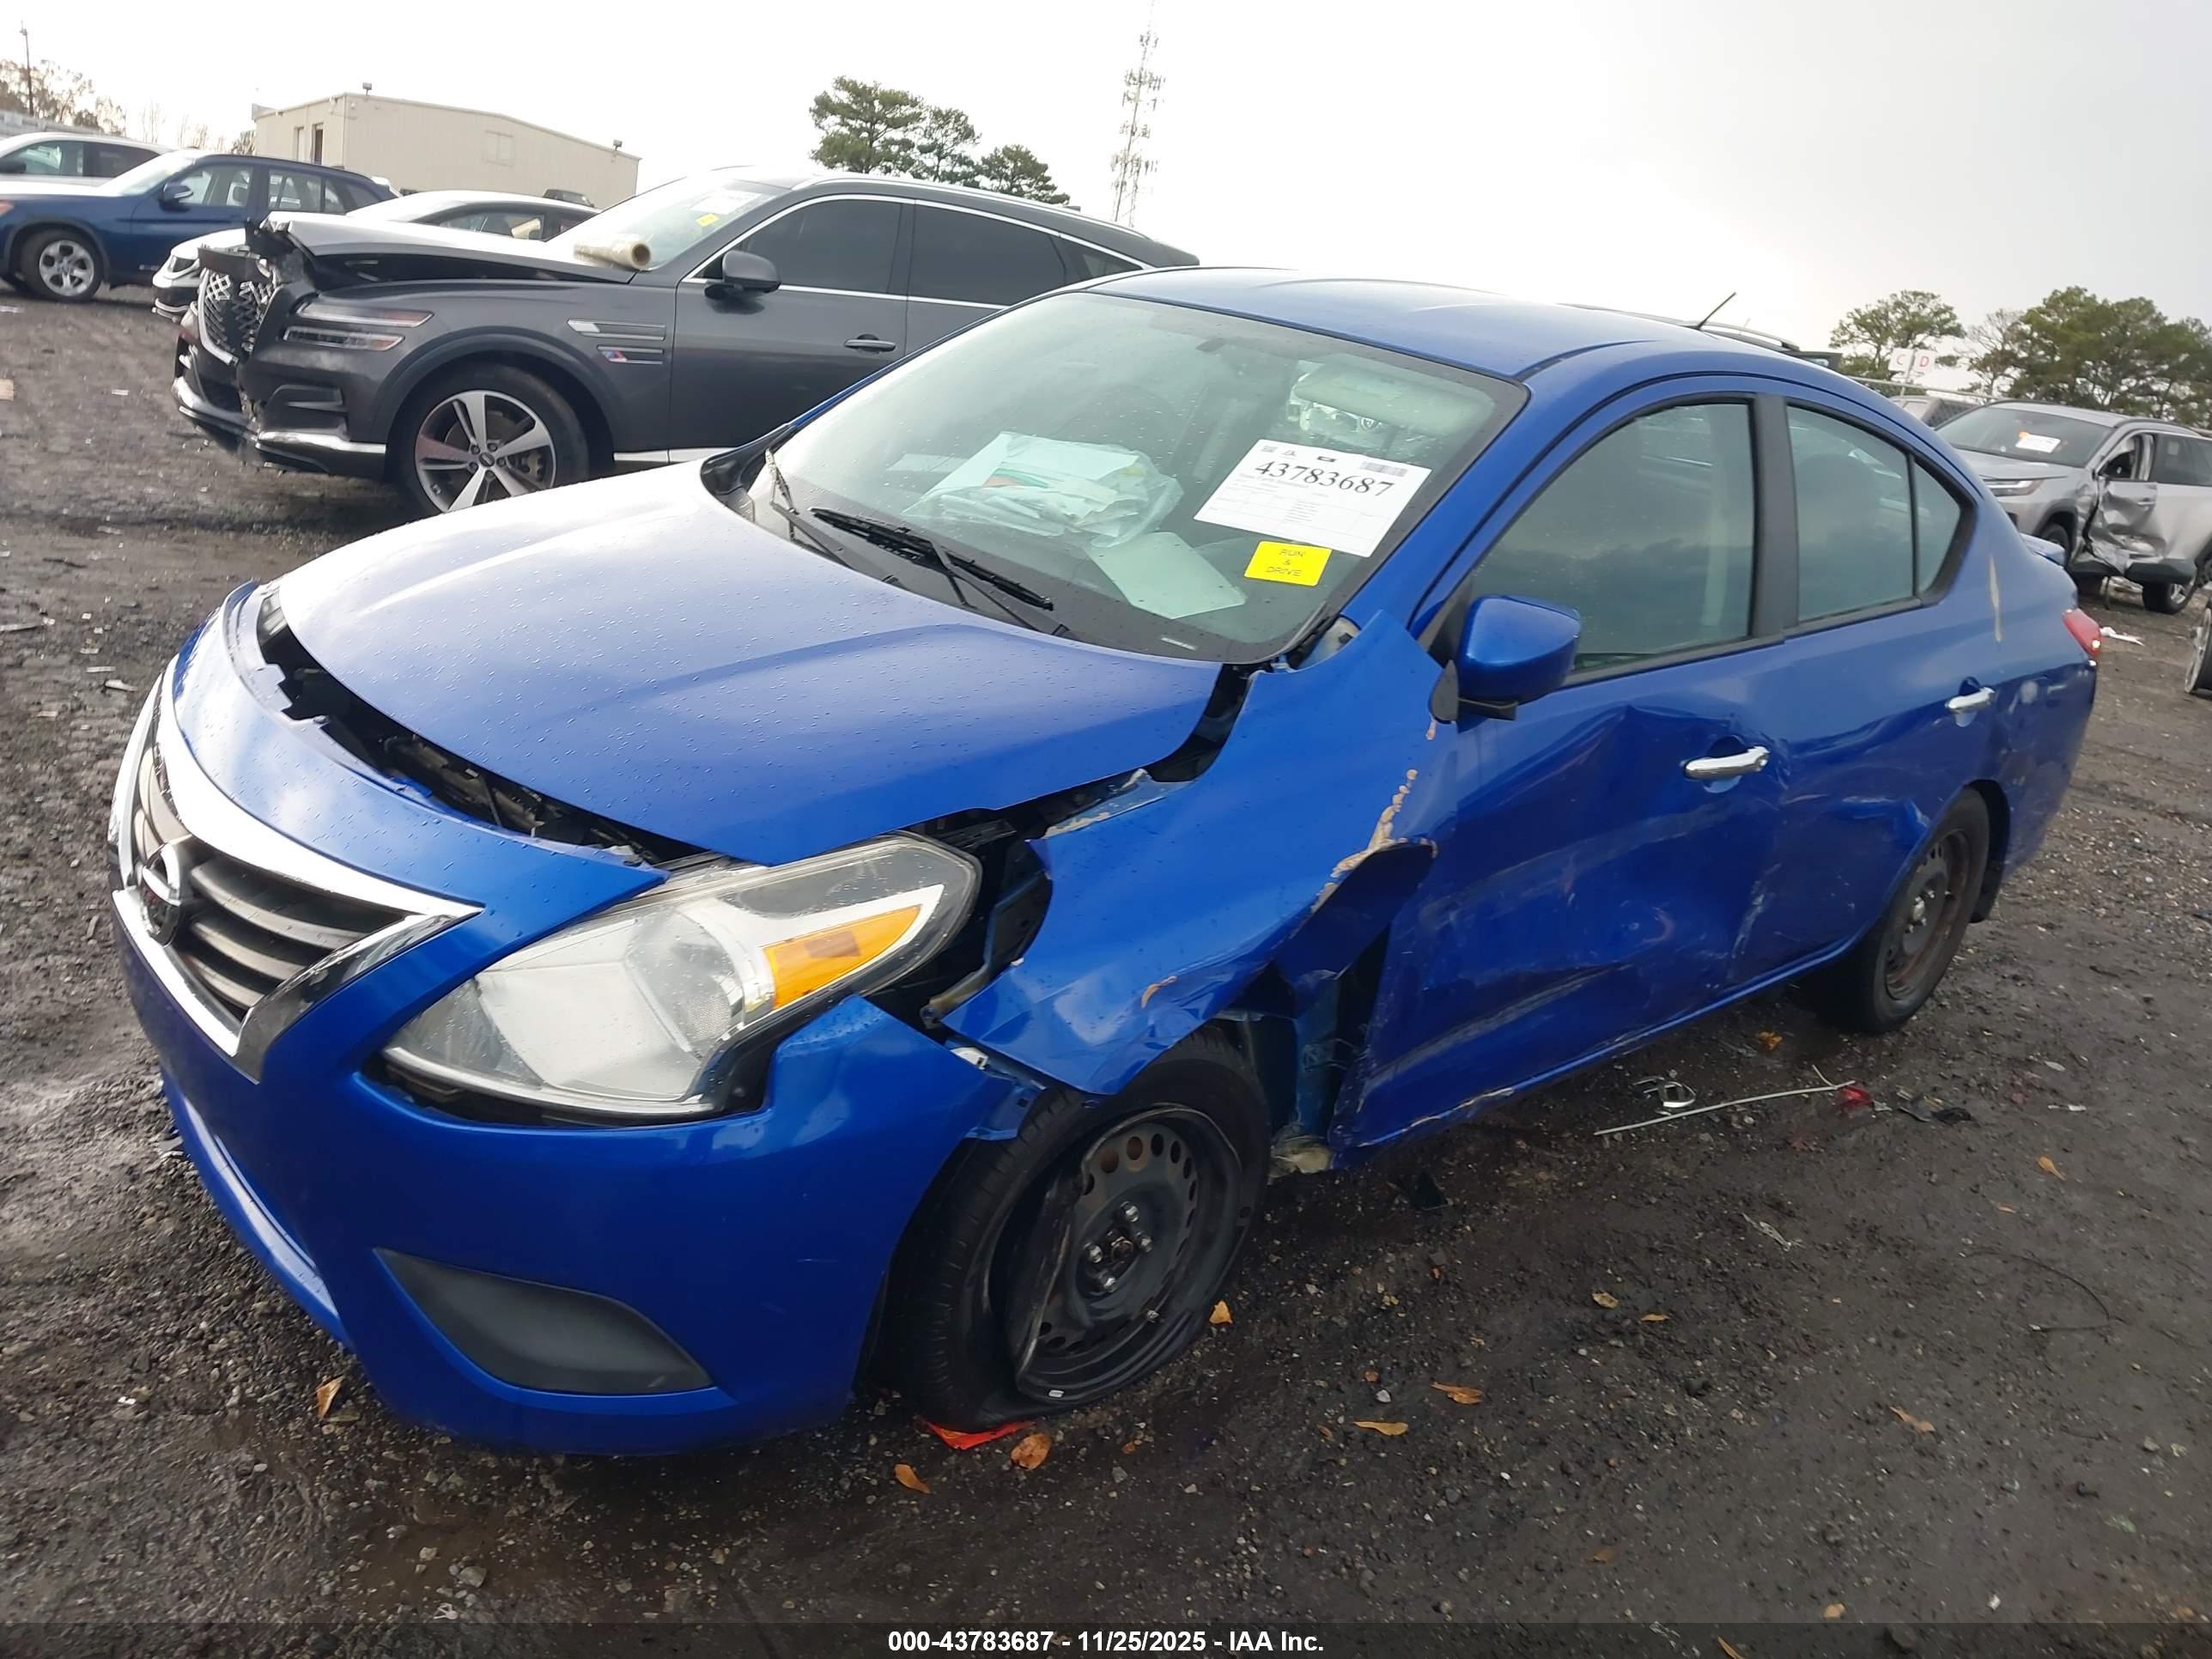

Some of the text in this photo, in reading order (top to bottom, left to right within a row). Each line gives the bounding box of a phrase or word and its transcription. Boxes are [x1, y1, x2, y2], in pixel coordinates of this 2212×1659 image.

[1896, 354, 1906, 365] C
[1919, 356, 1929, 367] D
[1255, 460, 1395, 496] 43783687
